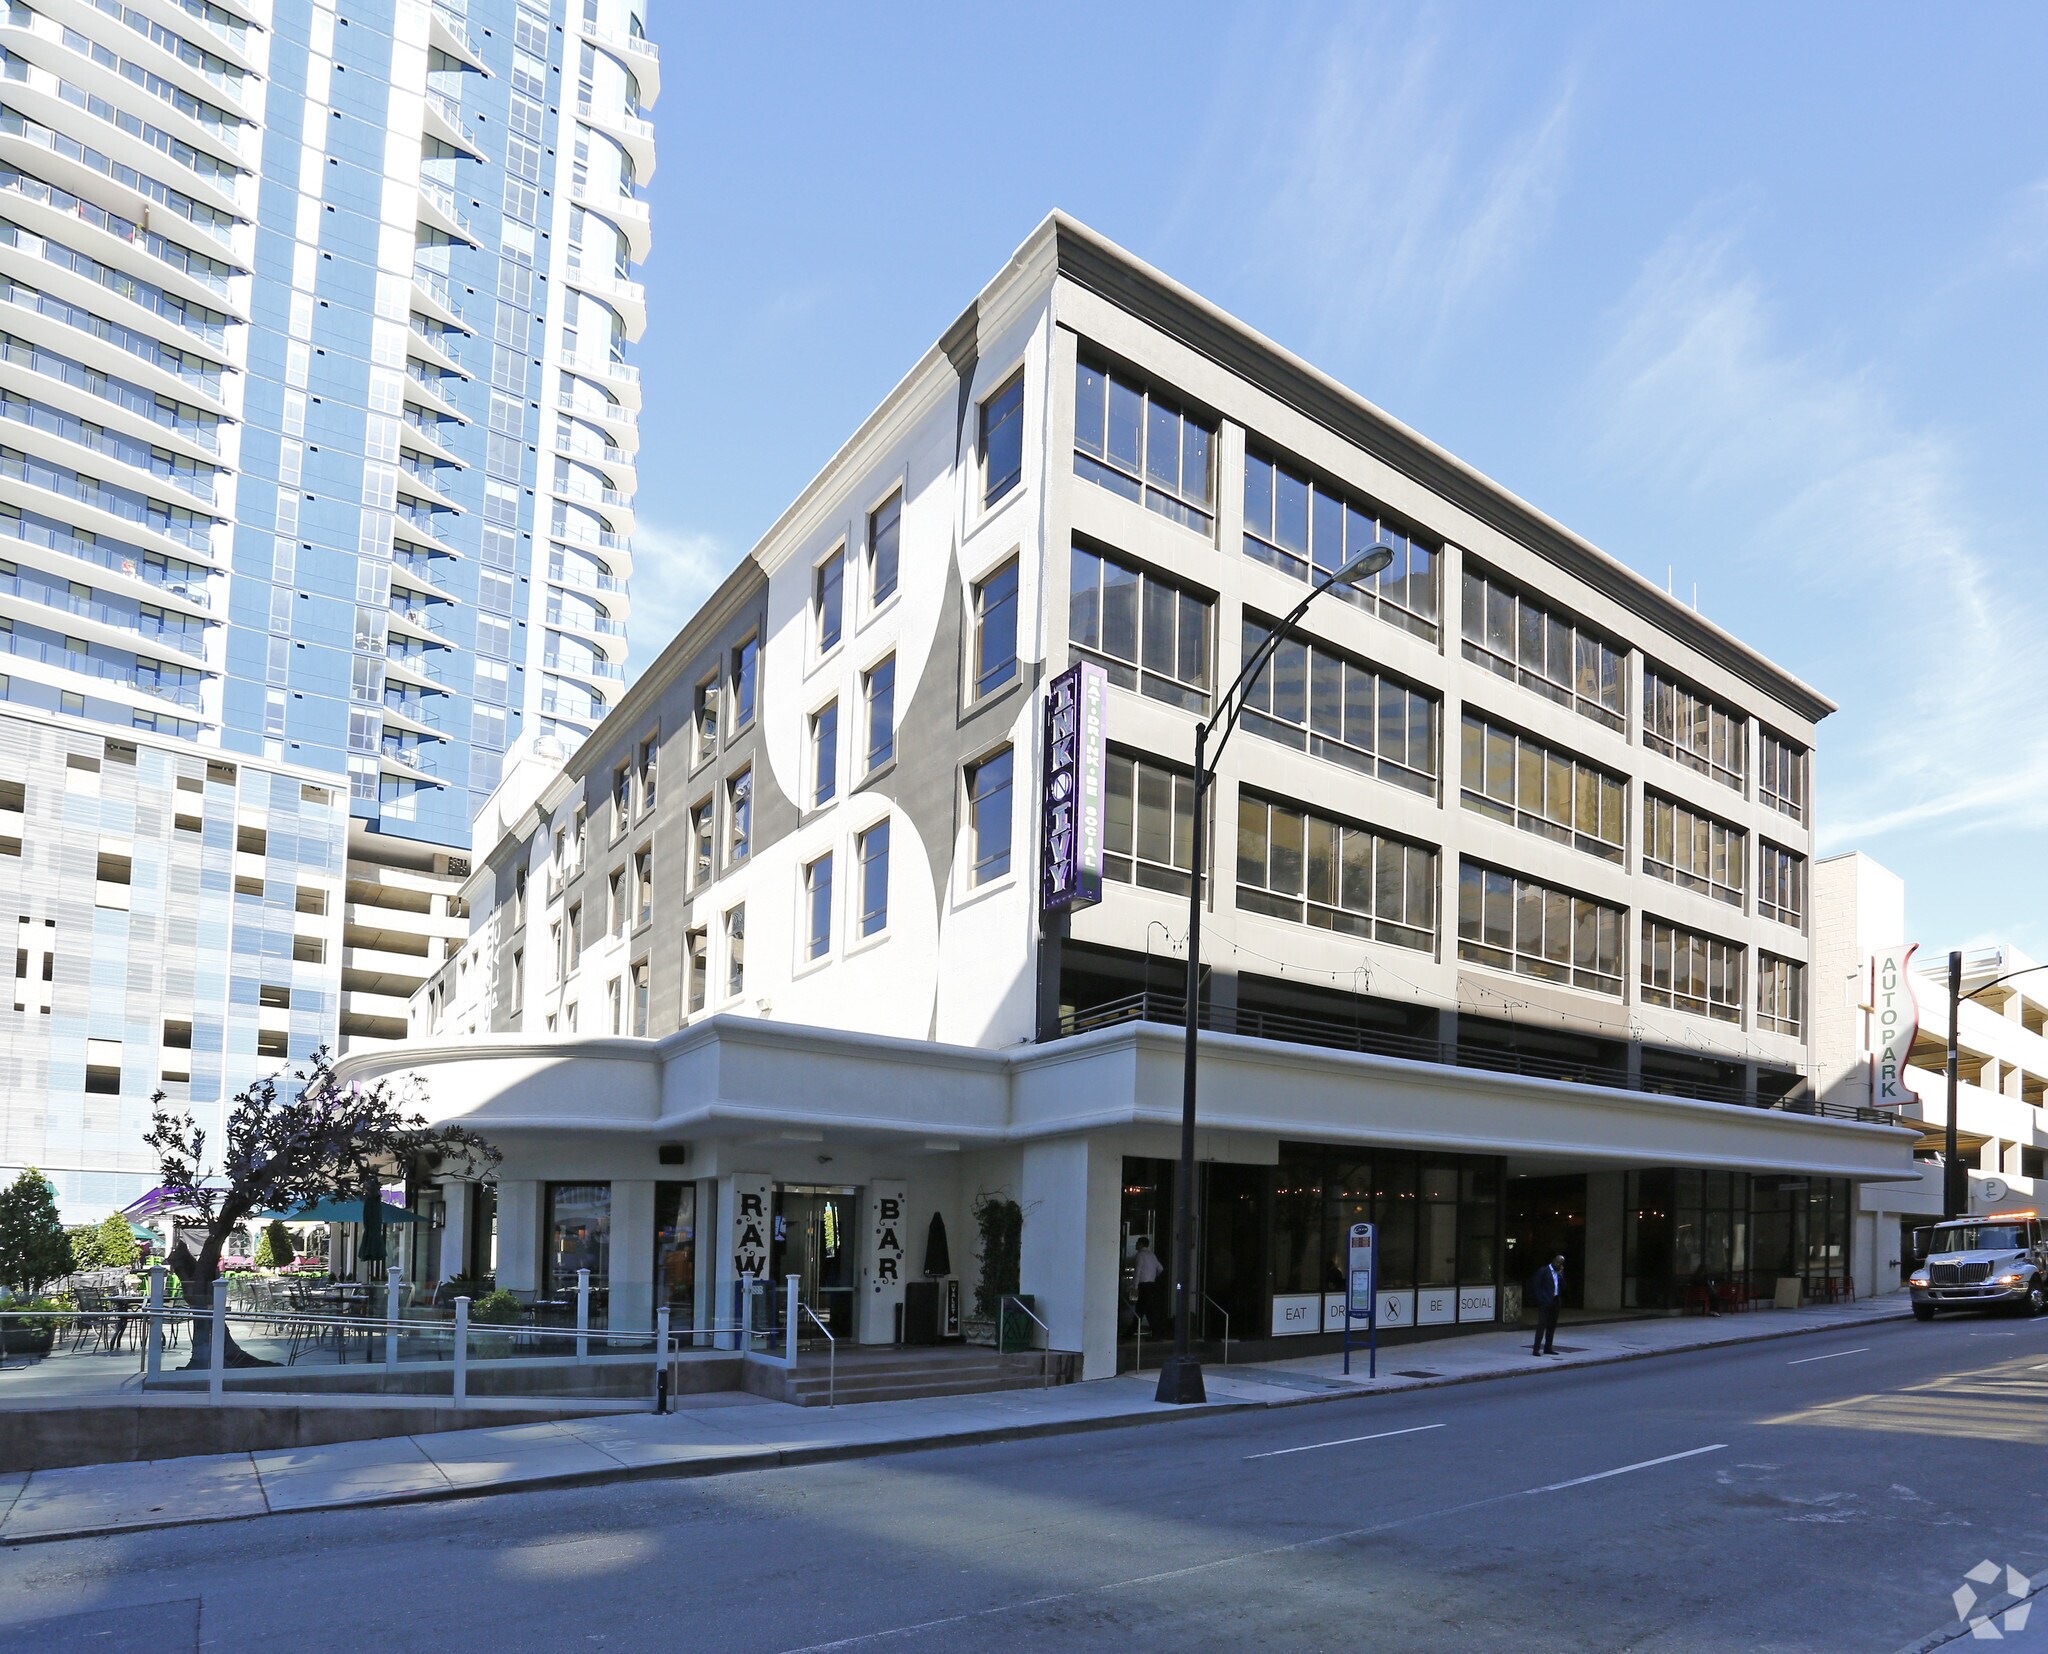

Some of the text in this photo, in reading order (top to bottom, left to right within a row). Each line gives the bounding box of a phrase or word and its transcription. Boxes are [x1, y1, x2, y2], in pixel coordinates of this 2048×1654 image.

[1051, 678, 1075, 773] INK
[1050, 801, 1071, 893] IVY
[1084, 805, 1098, 868] SOCIAL
[1880, 957, 1897, 1098] AUTOPARK
[1986, 1181, 1996, 1191] P
[734, 1193, 766, 1278] RAW
[878, 1198, 901, 1284] BAR
[1285, 1307, 1307, 1320] EAT
[1430, 1300, 1442, 1311] BE
[1461, 1297, 1492, 1310] SOCIAL
